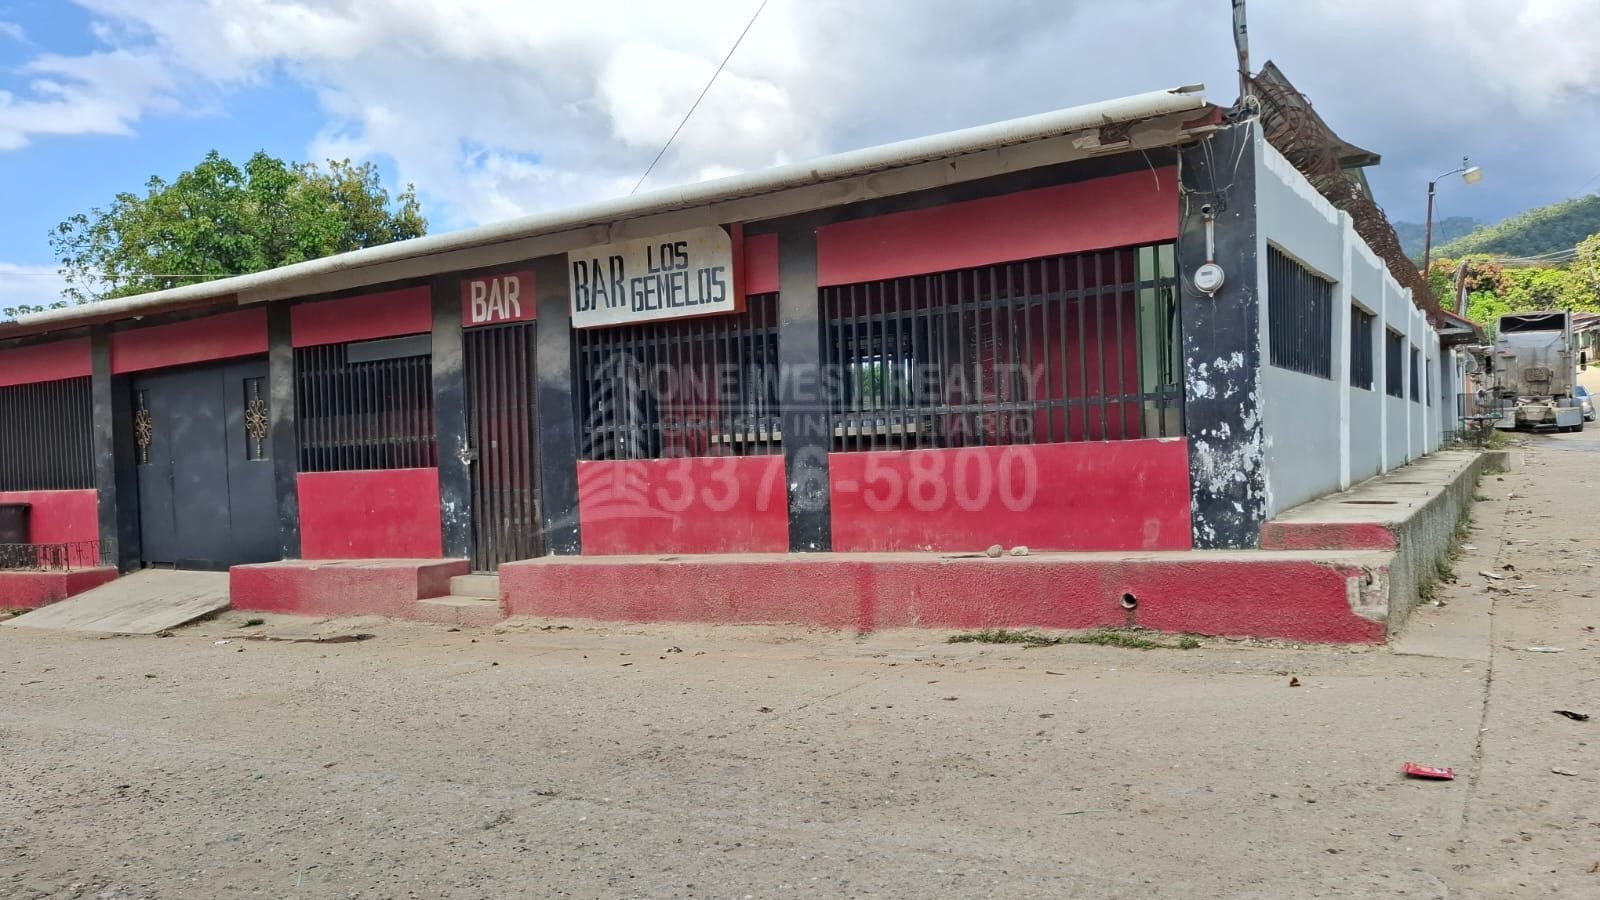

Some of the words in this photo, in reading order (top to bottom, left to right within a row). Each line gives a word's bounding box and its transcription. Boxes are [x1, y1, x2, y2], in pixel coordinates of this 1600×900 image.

[647, 241, 688, 273] LOS
[471, 276, 521, 322] BAR
[573, 255, 626, 312] BAR
[631, 266, 726, 312] GEMELOS
